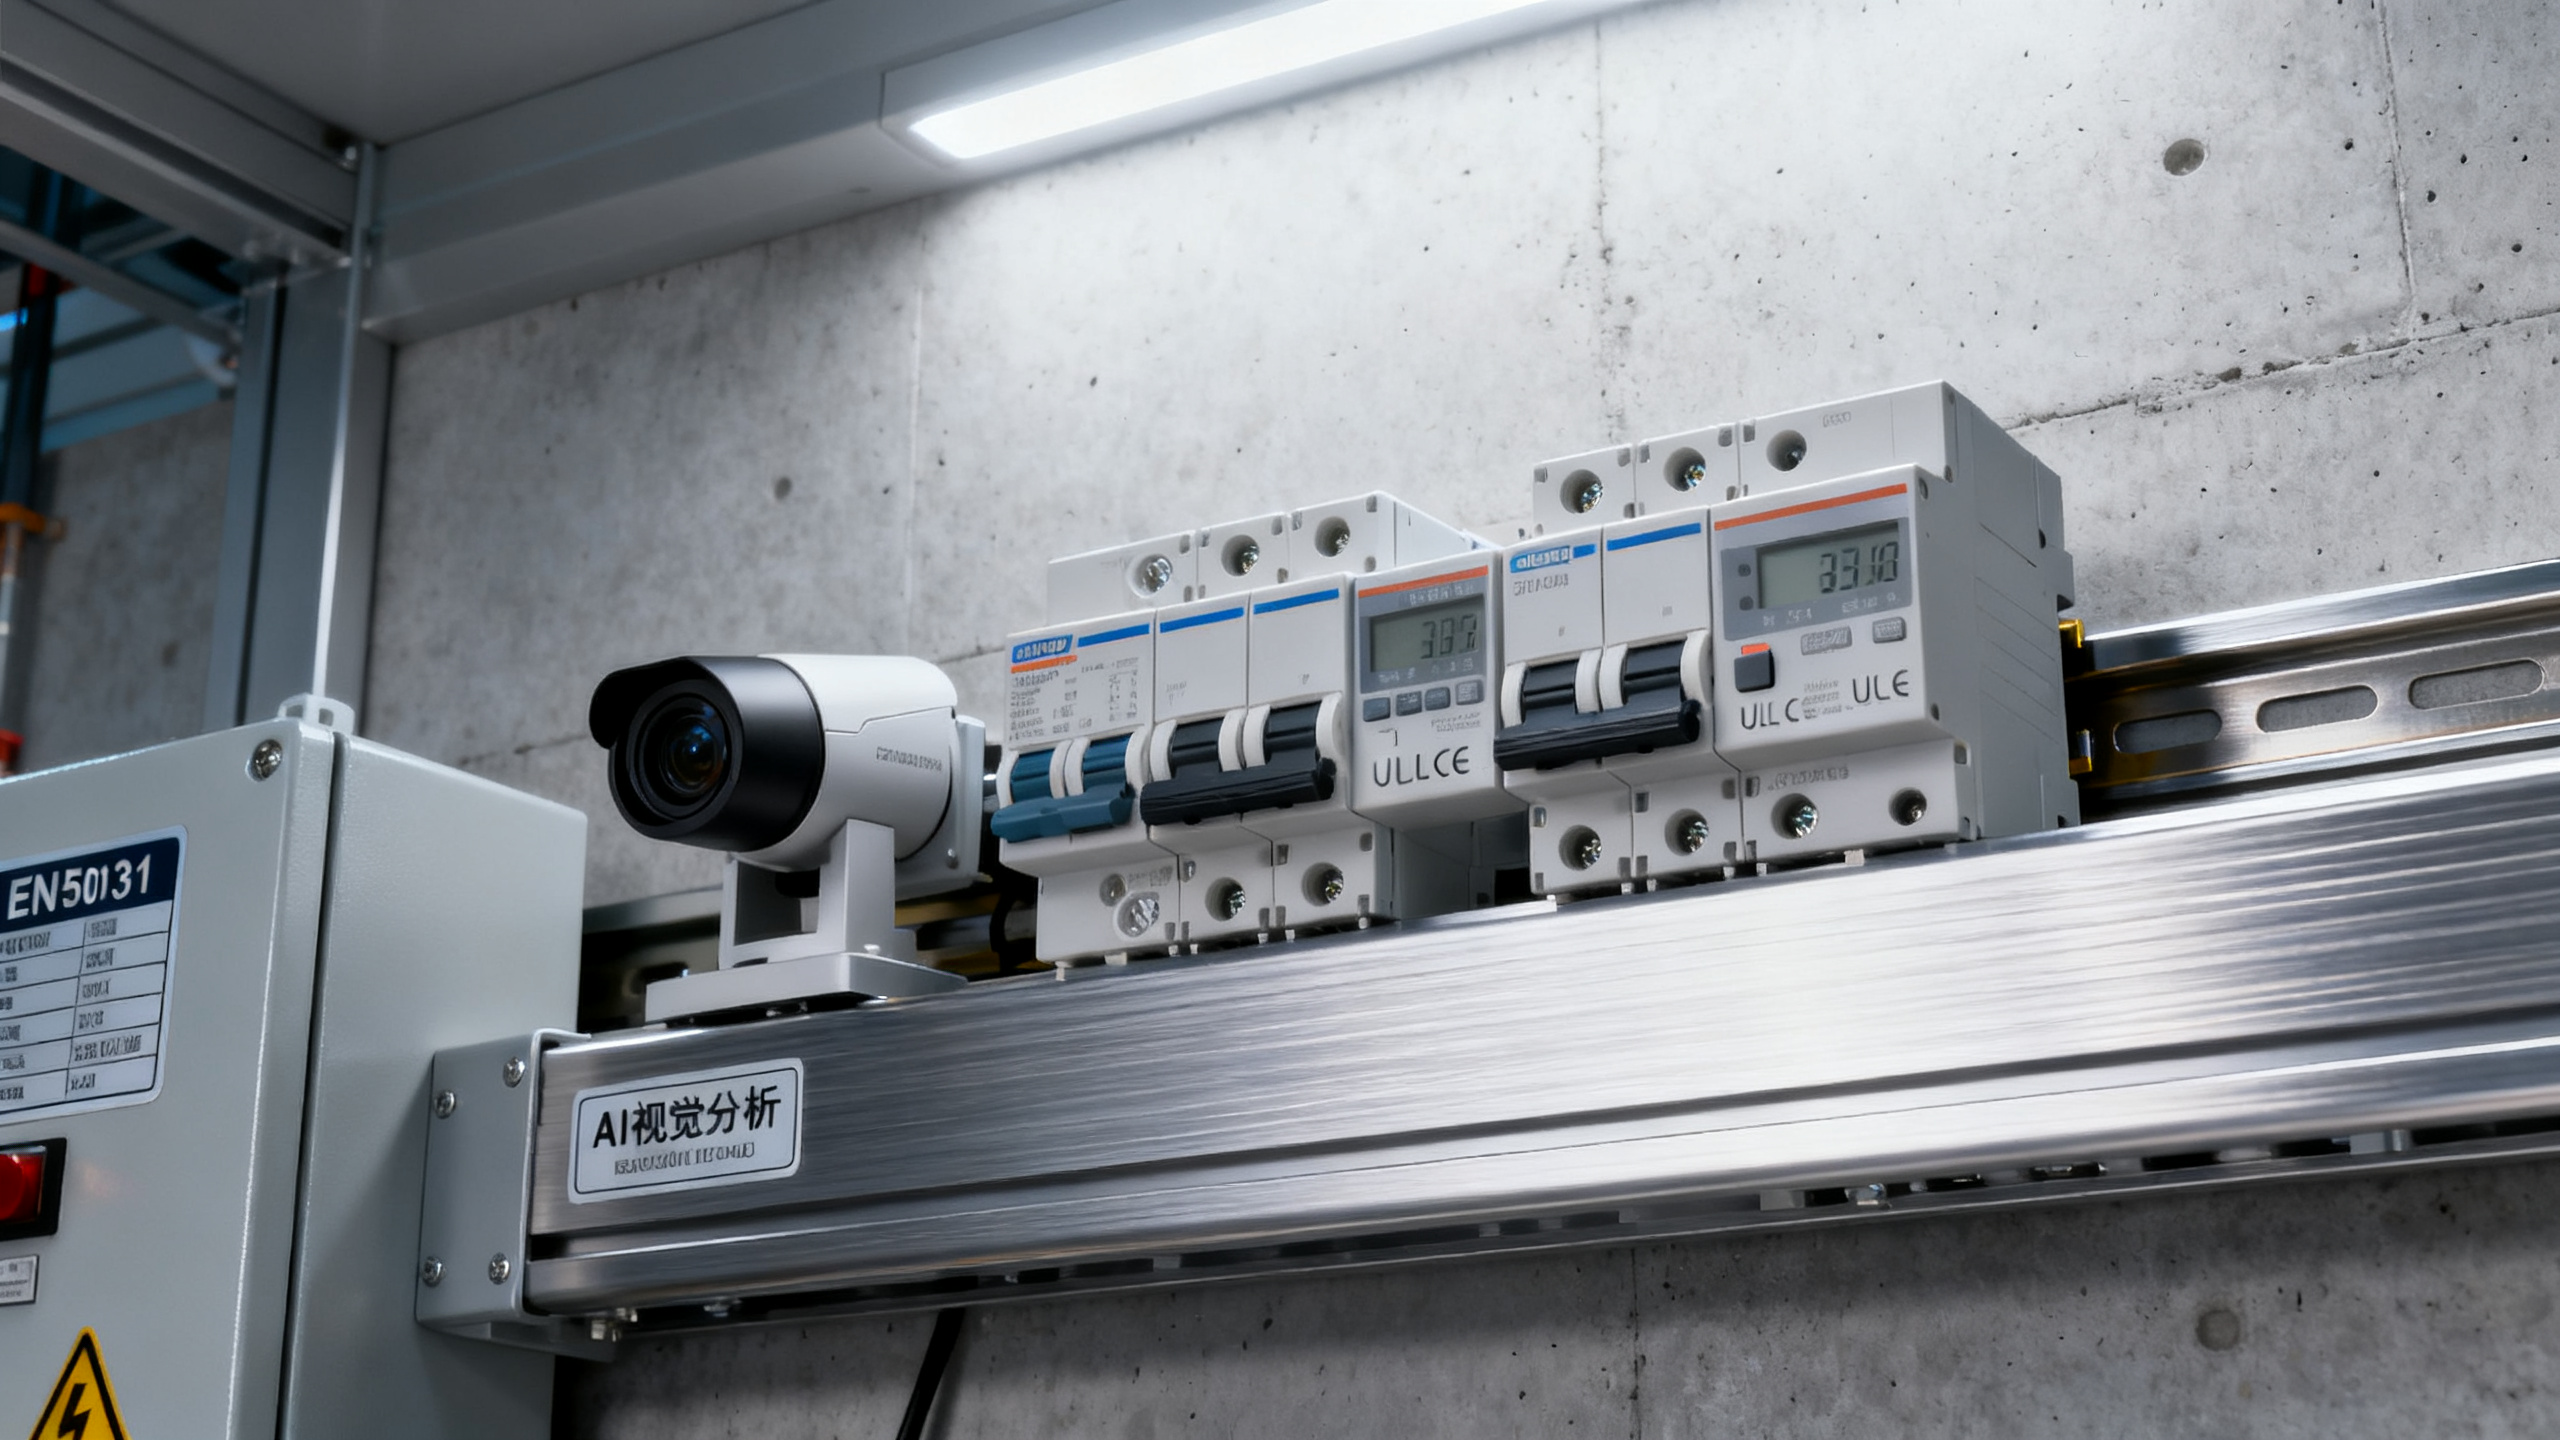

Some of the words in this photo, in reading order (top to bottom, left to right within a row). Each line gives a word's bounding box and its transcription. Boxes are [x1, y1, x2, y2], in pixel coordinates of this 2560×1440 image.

[7, 853, 152, 921] EN50131
[593, 1084, 782, 1149] AI视觉分析
